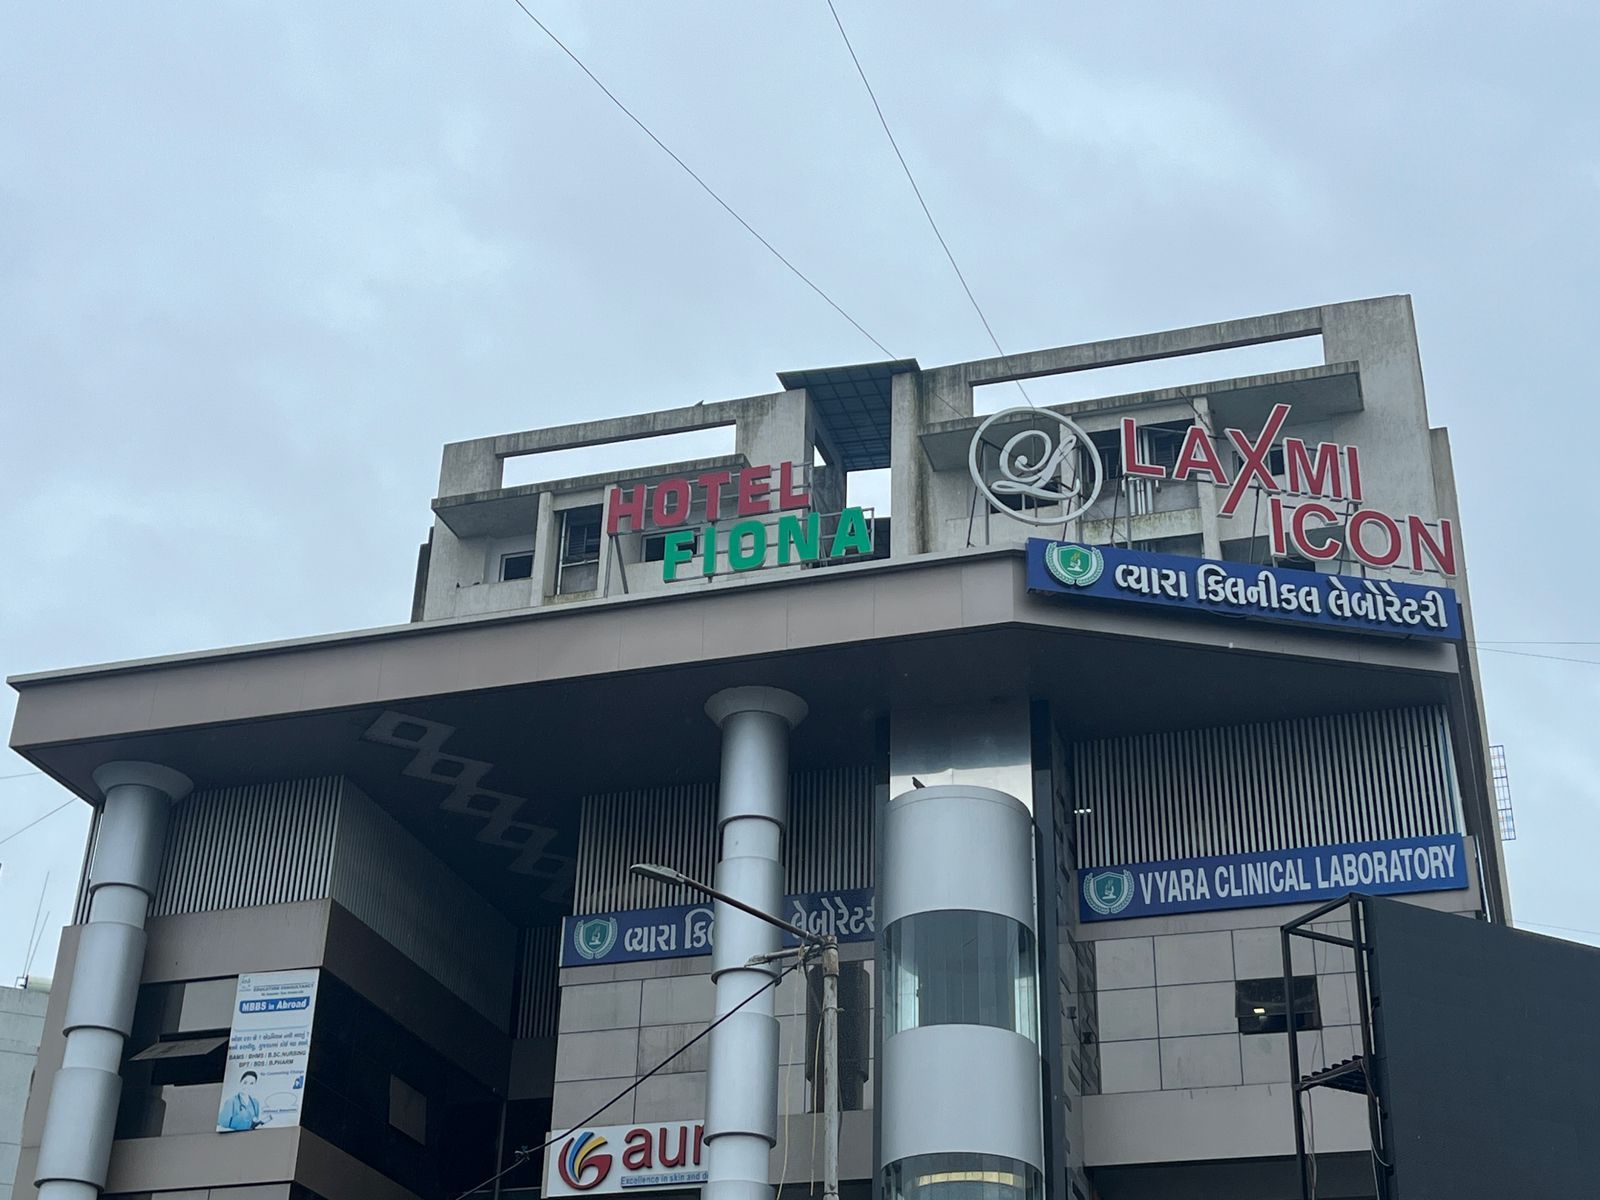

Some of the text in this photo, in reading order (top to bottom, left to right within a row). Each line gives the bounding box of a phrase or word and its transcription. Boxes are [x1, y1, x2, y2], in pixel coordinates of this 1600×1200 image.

[1121, 403, 1364, 518] LAXMI
[607, 461, 810, 535] HOTEL
[663, 506, 873, 583] FIONA
[1267, 495, 1457, 579] ICON
[1328, 576, 1448, 628] લેબોરેટરી
[1139, 844, 1456, 905] VYARA CLINICAL LABORATORY
[241, 1001, 267, 1012] MBBS
[276, 998, 307, 1010] Abroad
[621, 1175, 660, 1185] Excellence
[660, 1175, 668, 1183] in
[669, 1172, 685, 1182] skin
[686, 1171, 700, 1181] and
